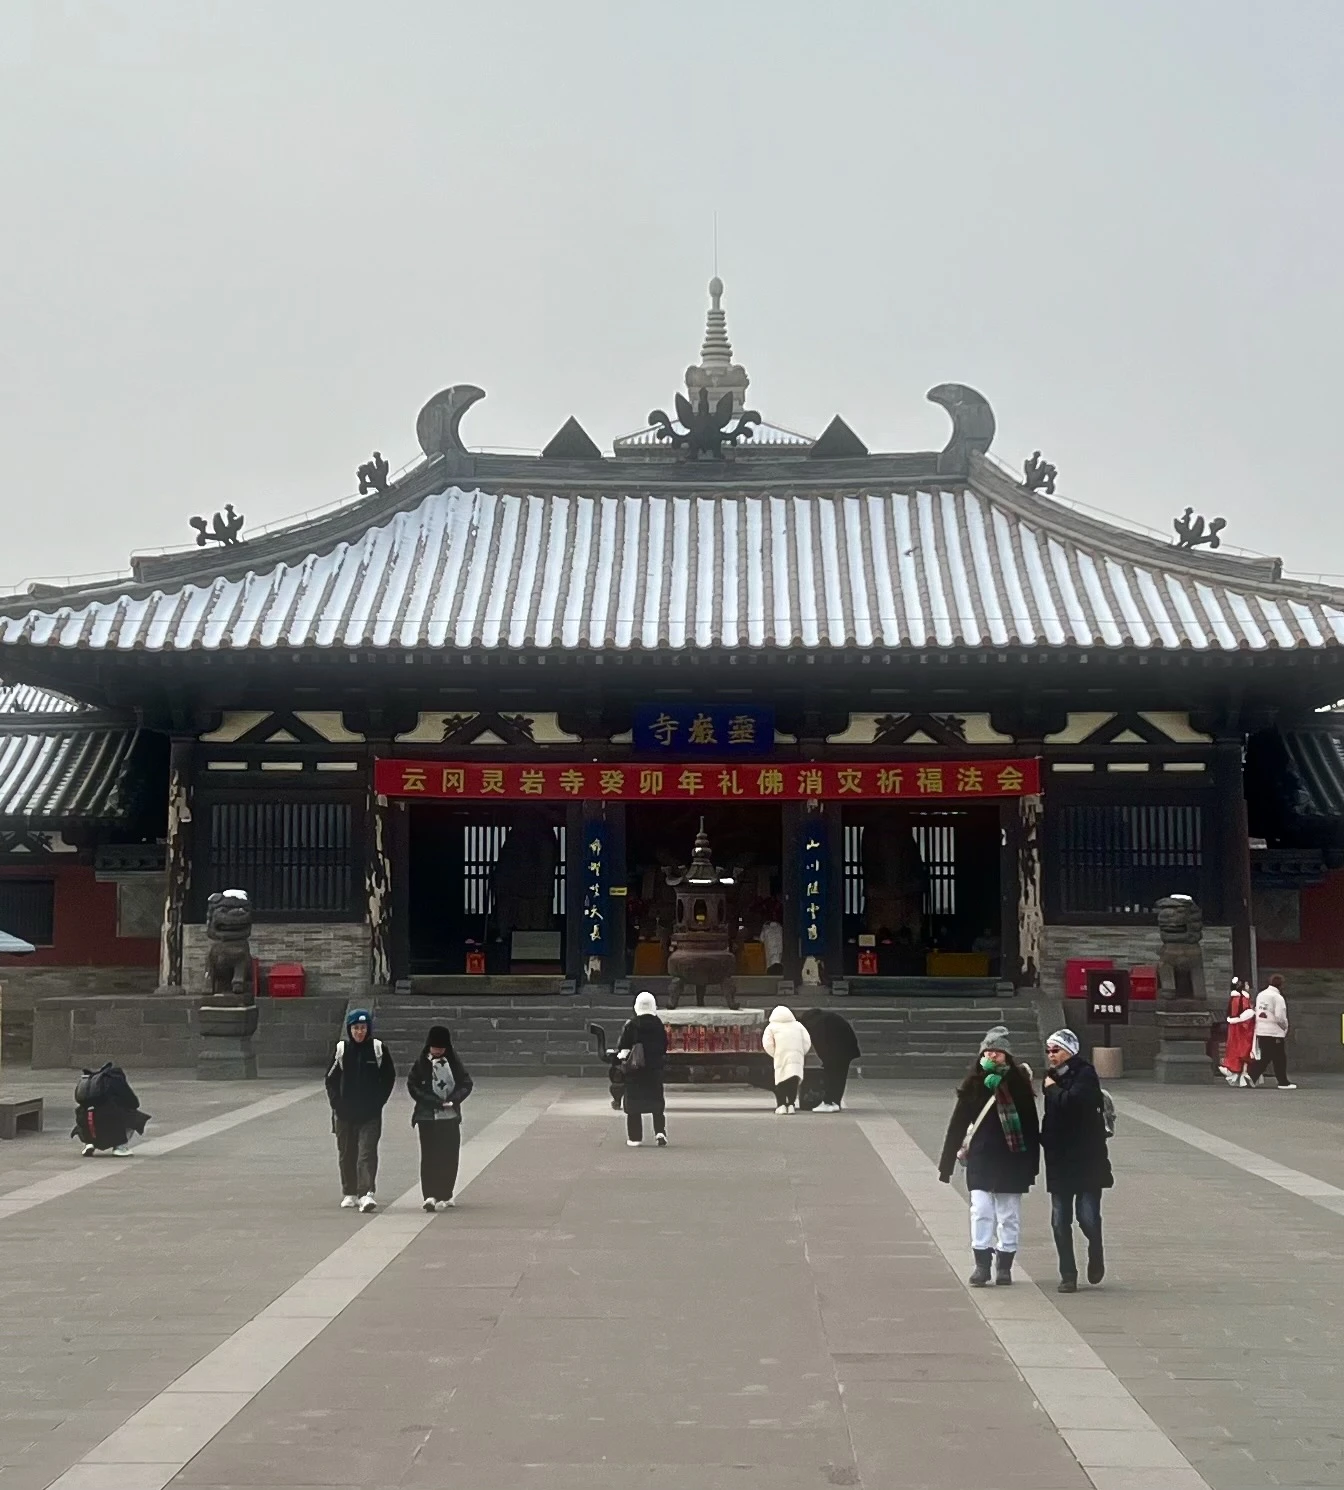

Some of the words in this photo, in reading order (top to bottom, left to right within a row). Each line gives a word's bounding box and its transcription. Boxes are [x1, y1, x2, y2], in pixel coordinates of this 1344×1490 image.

[401, 766, 1025, 795] 云冈灵岩寺癸卯年礼佛消灾祈福法会
